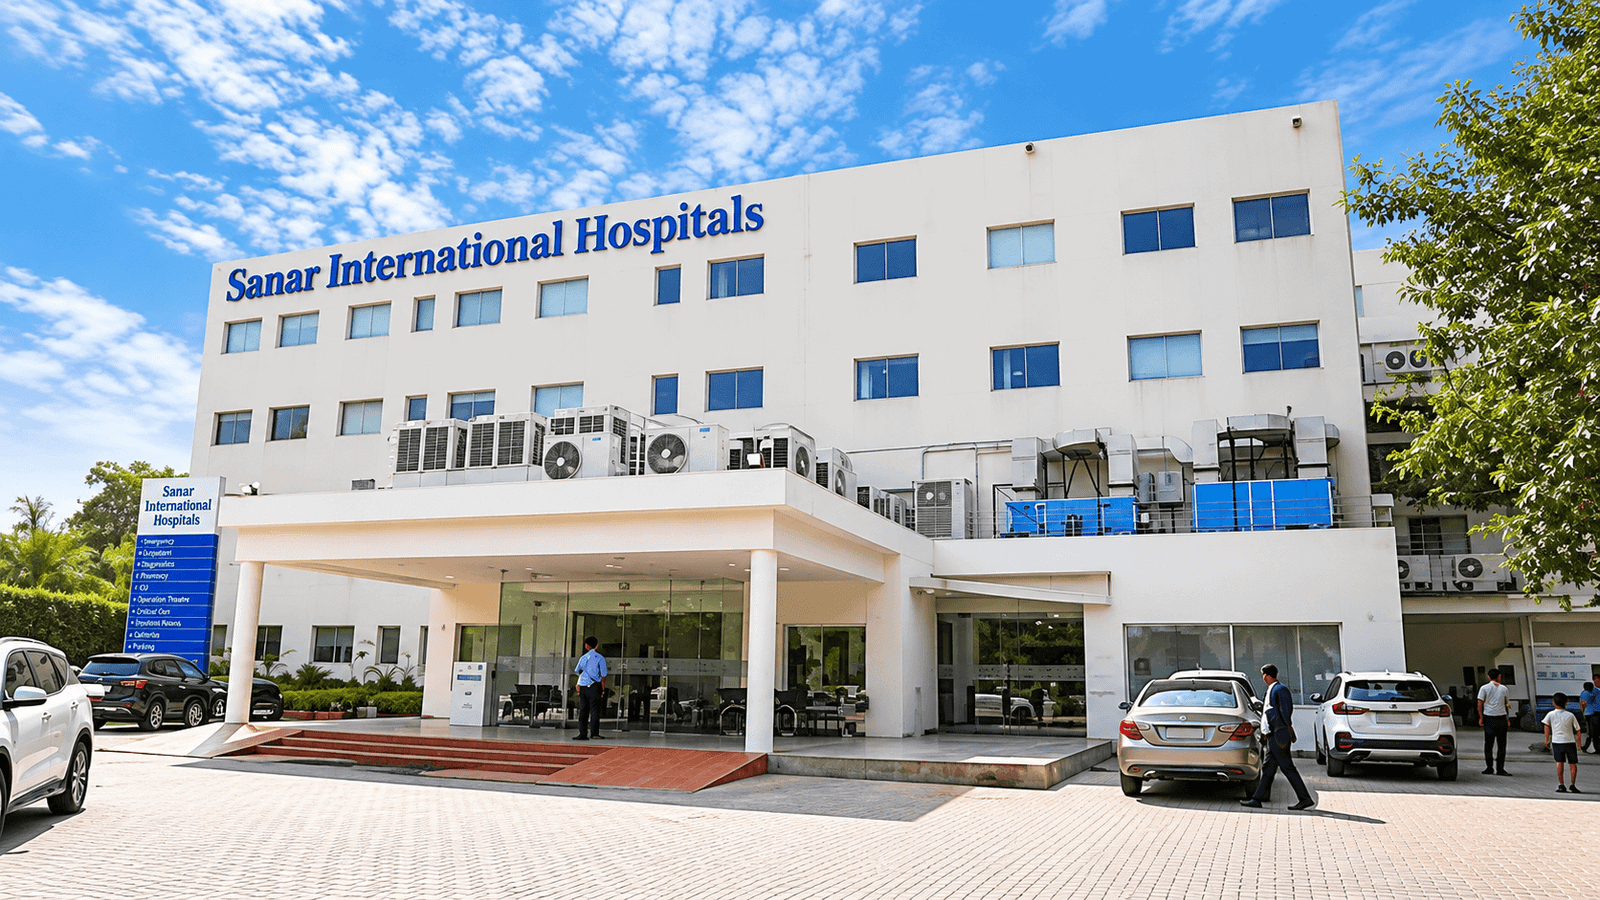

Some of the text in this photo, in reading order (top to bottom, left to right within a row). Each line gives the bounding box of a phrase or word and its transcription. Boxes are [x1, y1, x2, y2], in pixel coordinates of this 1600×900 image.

[225, 194, 765, 302] Sanar International Hospitals
[162, 485, 195, 497] Sanar
[144, 499, 212, 512] International
[153, 514, 200, 529] Hospitals
